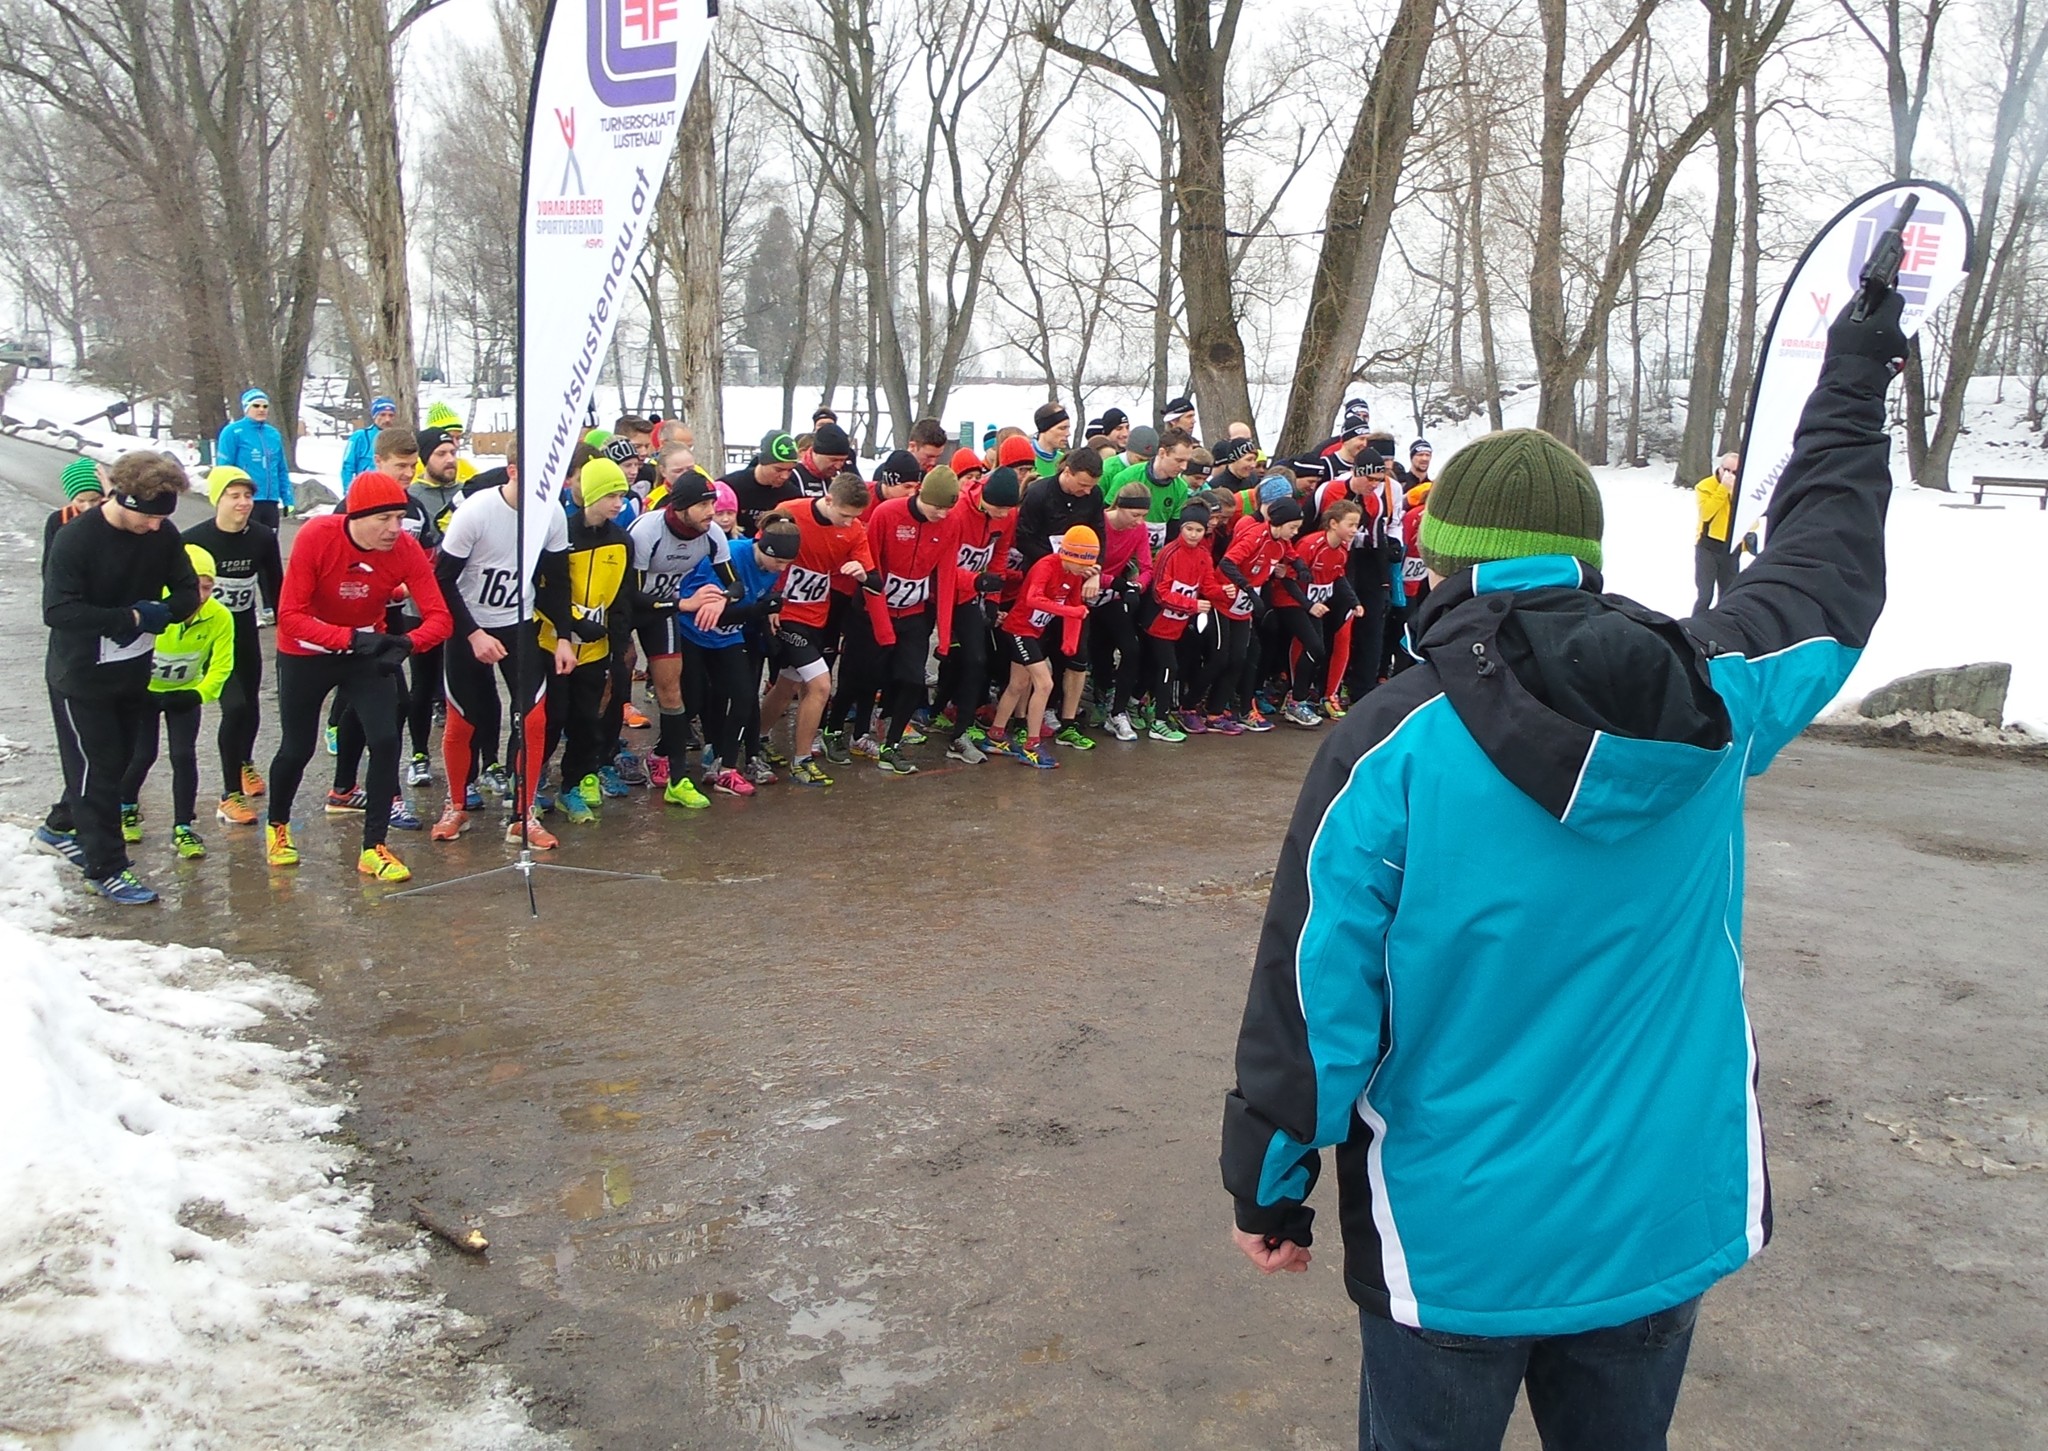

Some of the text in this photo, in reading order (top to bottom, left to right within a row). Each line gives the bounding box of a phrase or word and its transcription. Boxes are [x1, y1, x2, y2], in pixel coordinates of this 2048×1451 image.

[601, 111, 675, 131] TURNERSCHAFT
[613, 130, 662, 149] LUSTENAU
[538, 200, 603, 215] VORARLBERGER
[537, 220, 603, 234] SPORTVERBAND
[535, 166, 650, 504] www.tslustenau.at
[221, 559, 252, 568] SPORT
[478, 567, 519, 608] 162
[787, 568, 828, 601] 248
[887, 577, 925, 607] 221
